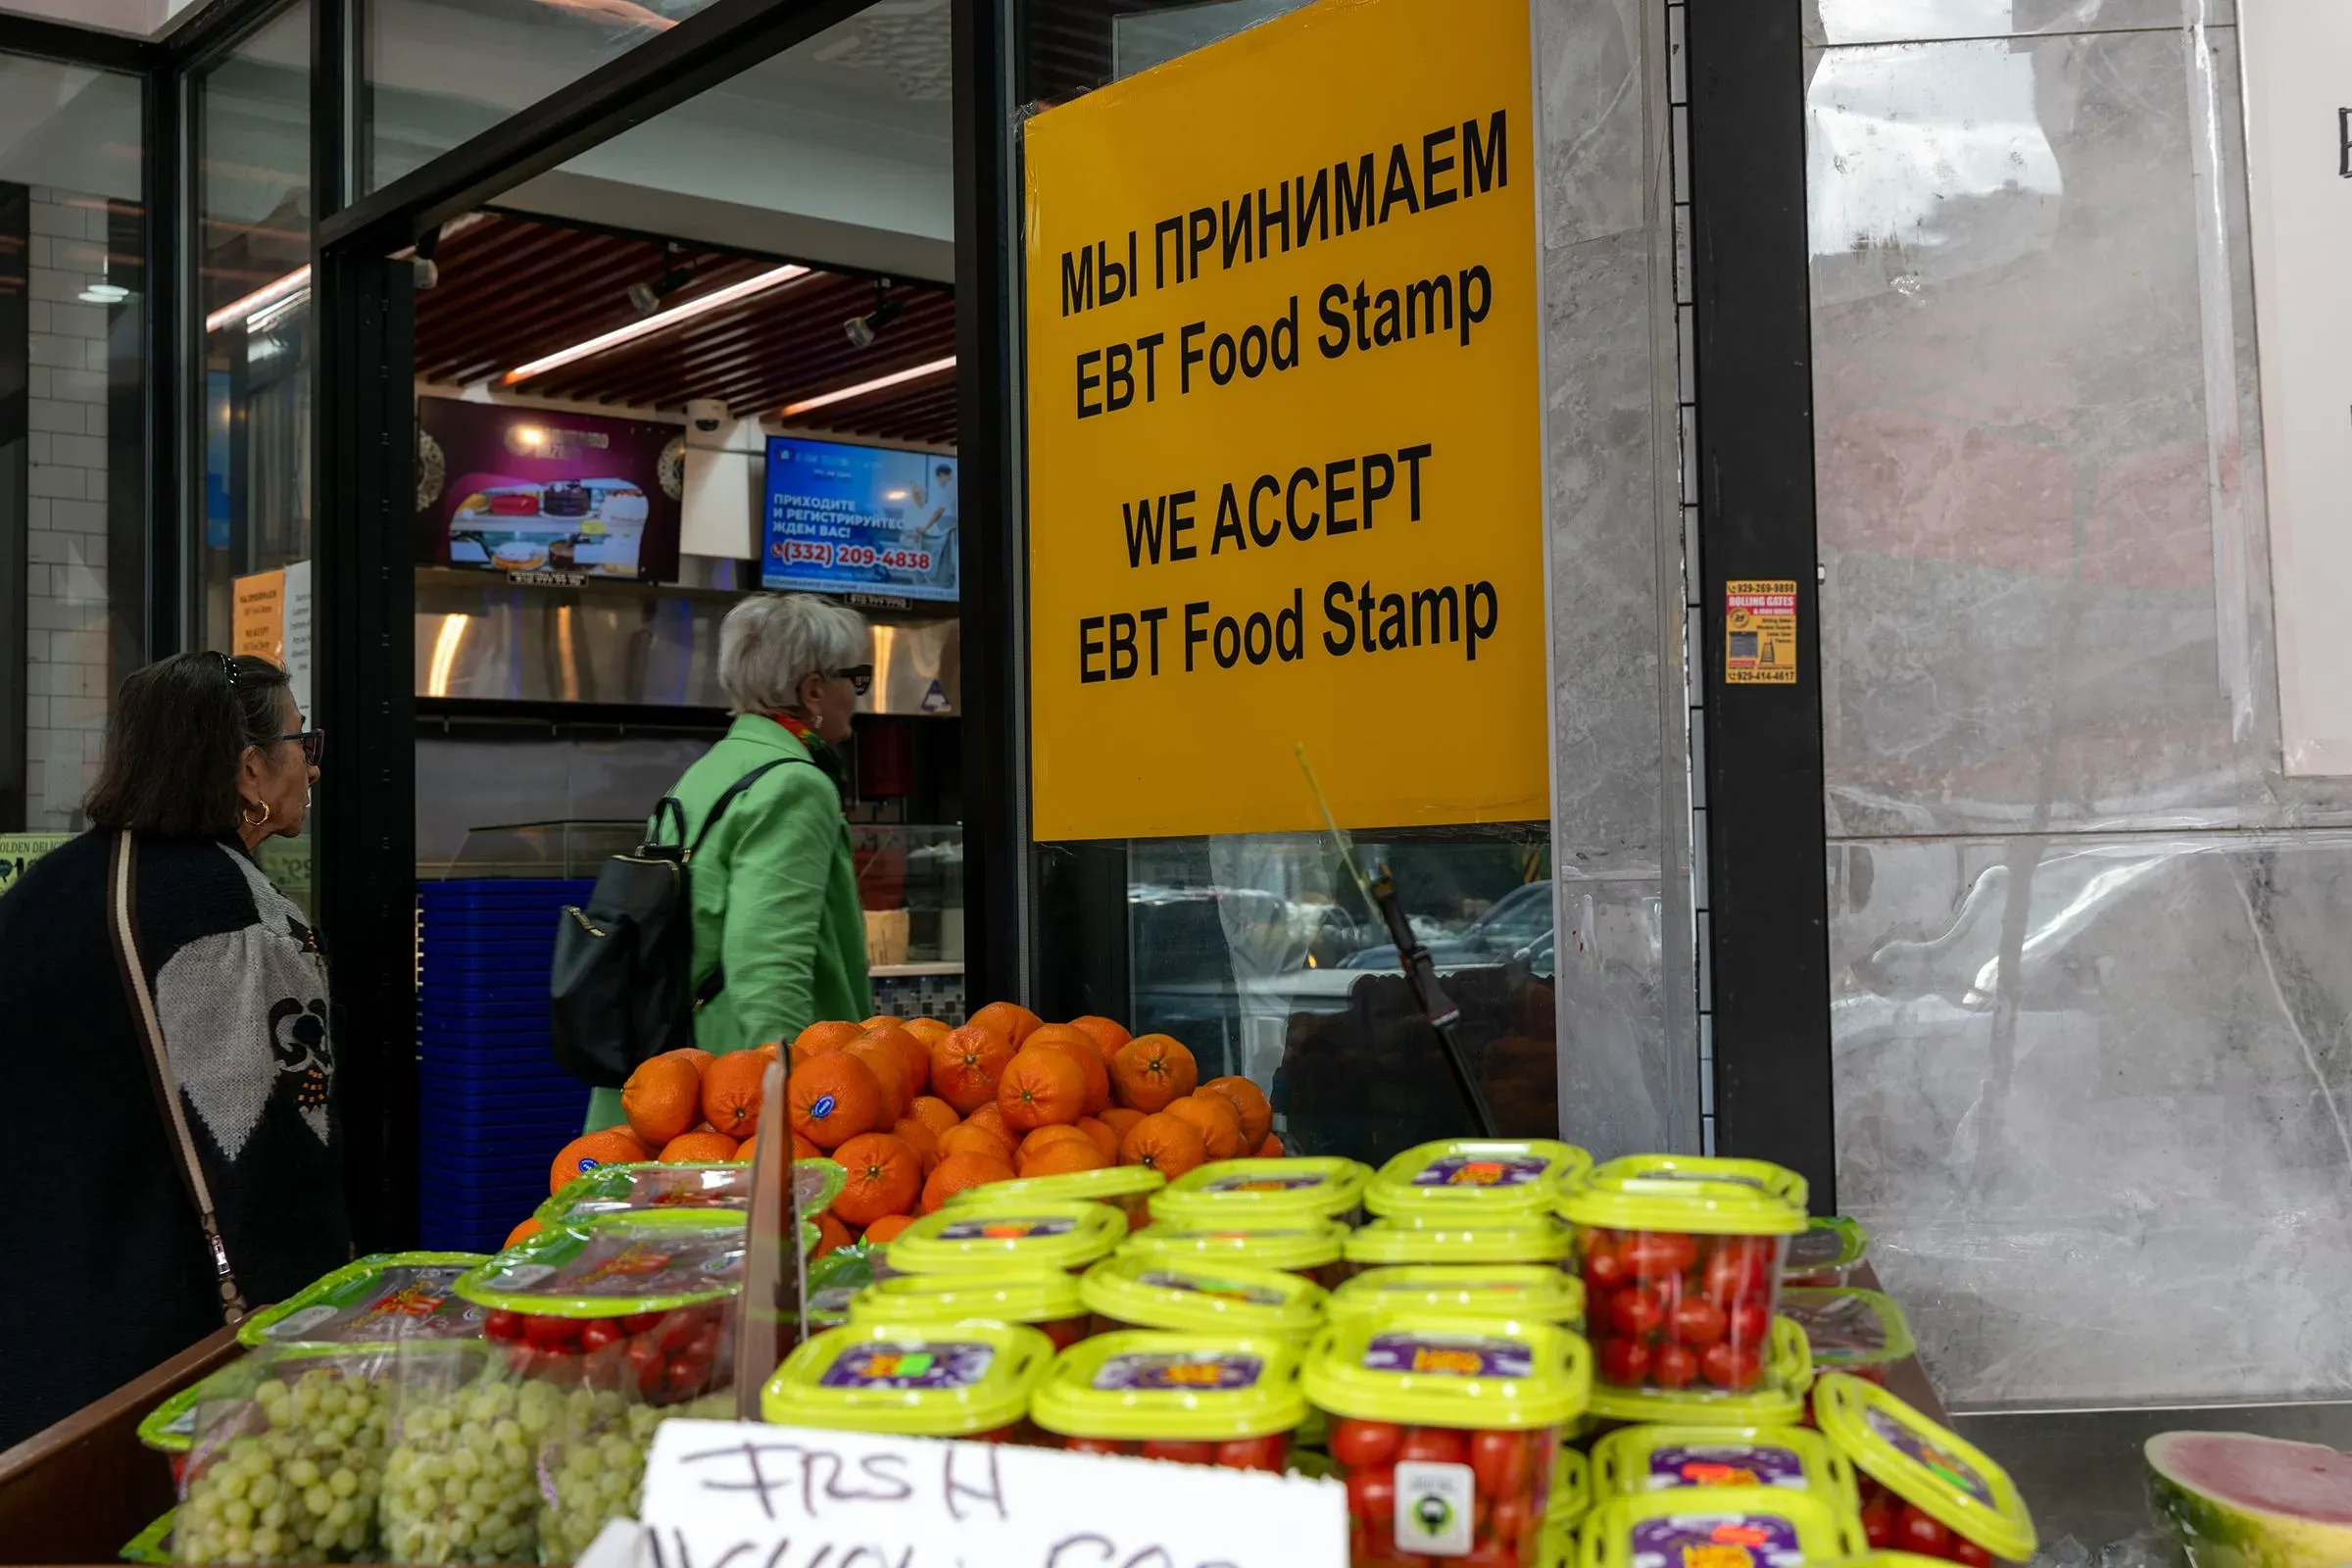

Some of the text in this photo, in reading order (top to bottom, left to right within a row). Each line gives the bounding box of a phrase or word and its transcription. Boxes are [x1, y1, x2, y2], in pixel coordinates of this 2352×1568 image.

[1061, 110, 1507, 317] МЫ ПРИНИМАЕМ
[1077, 266, 1491, 418] EBT Food Stamp
[773, 493, 857, 512] ПРИХОДИТЕ
[773, 507, 783, 519] И
[1123, 444, 1431, 567] WE ACCEPT
[819, 522, 851, 539] ВАС!
[783, 540, 931, 569] (332) 209-4838
[1081, 580, 1497, 683] EBT Food Stamp
[0, 842, 30, 853] OLDEN
